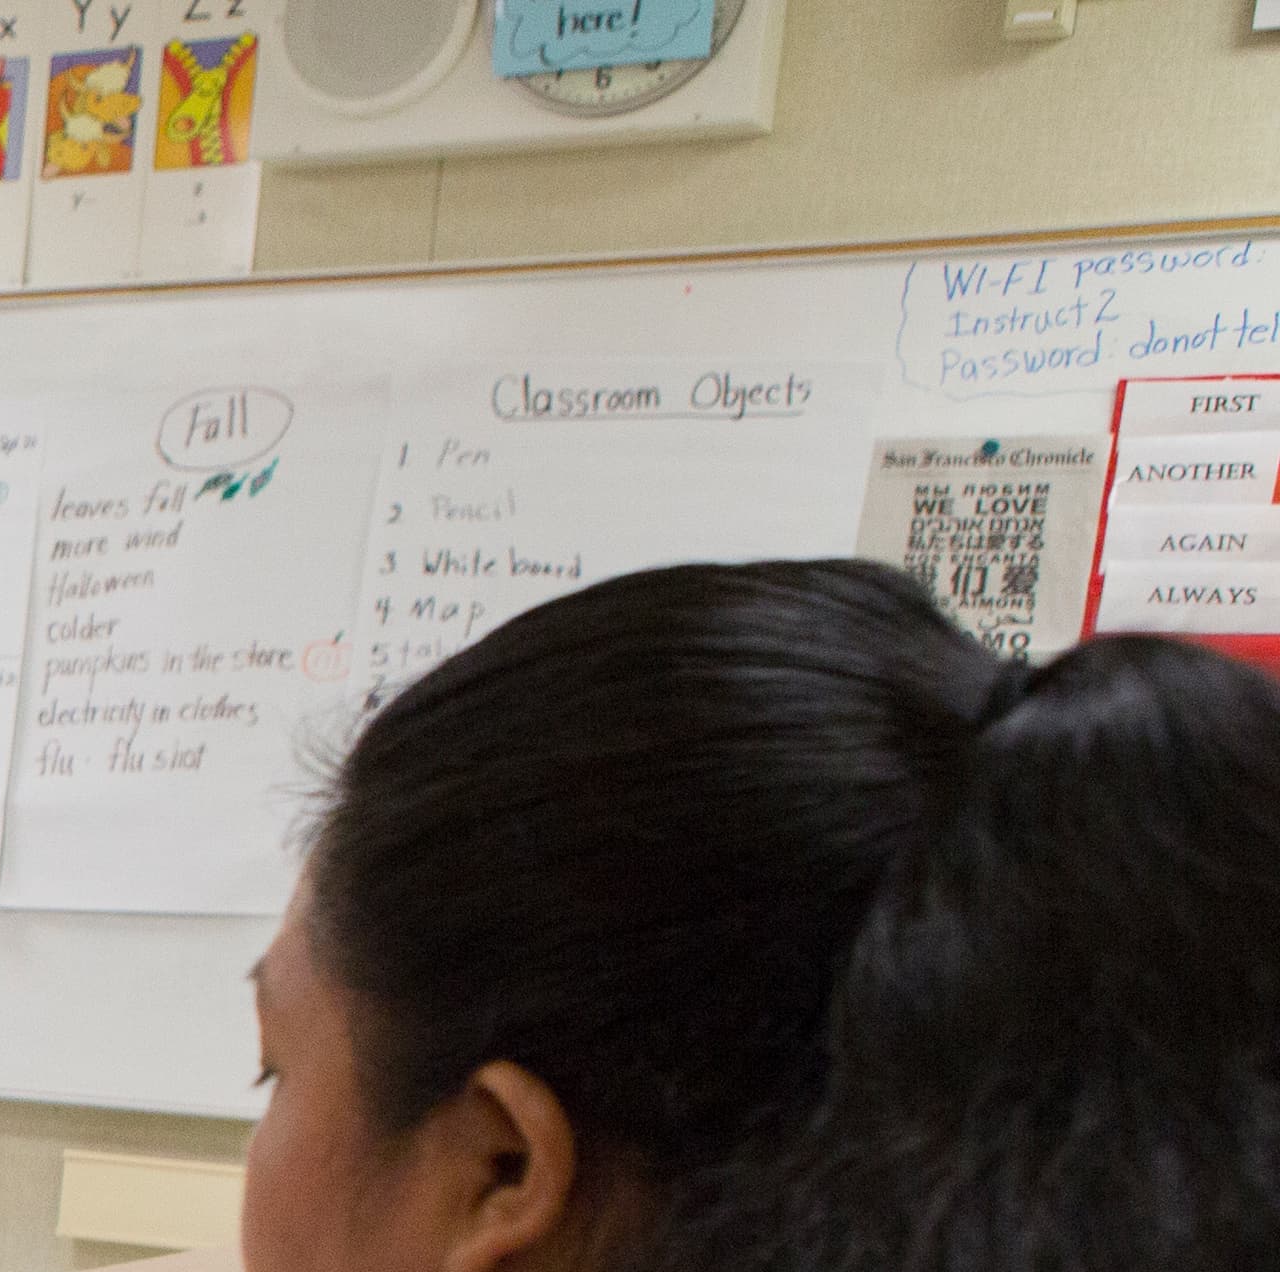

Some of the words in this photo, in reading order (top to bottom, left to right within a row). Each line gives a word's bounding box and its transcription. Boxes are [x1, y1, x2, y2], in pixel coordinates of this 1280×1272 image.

[491, 372, 661, 420] Classroom
[1190, 394, 1262, 414] FIRST
[1128, 463, 1257, 482] ANOTHER
[914, 499, 953, 515] WE
[976, 498, 1047, 515] LOVE
[1160, 533, 1247, 552] AGAIN
[1147, 585, 1257, 605] ALWAYS
